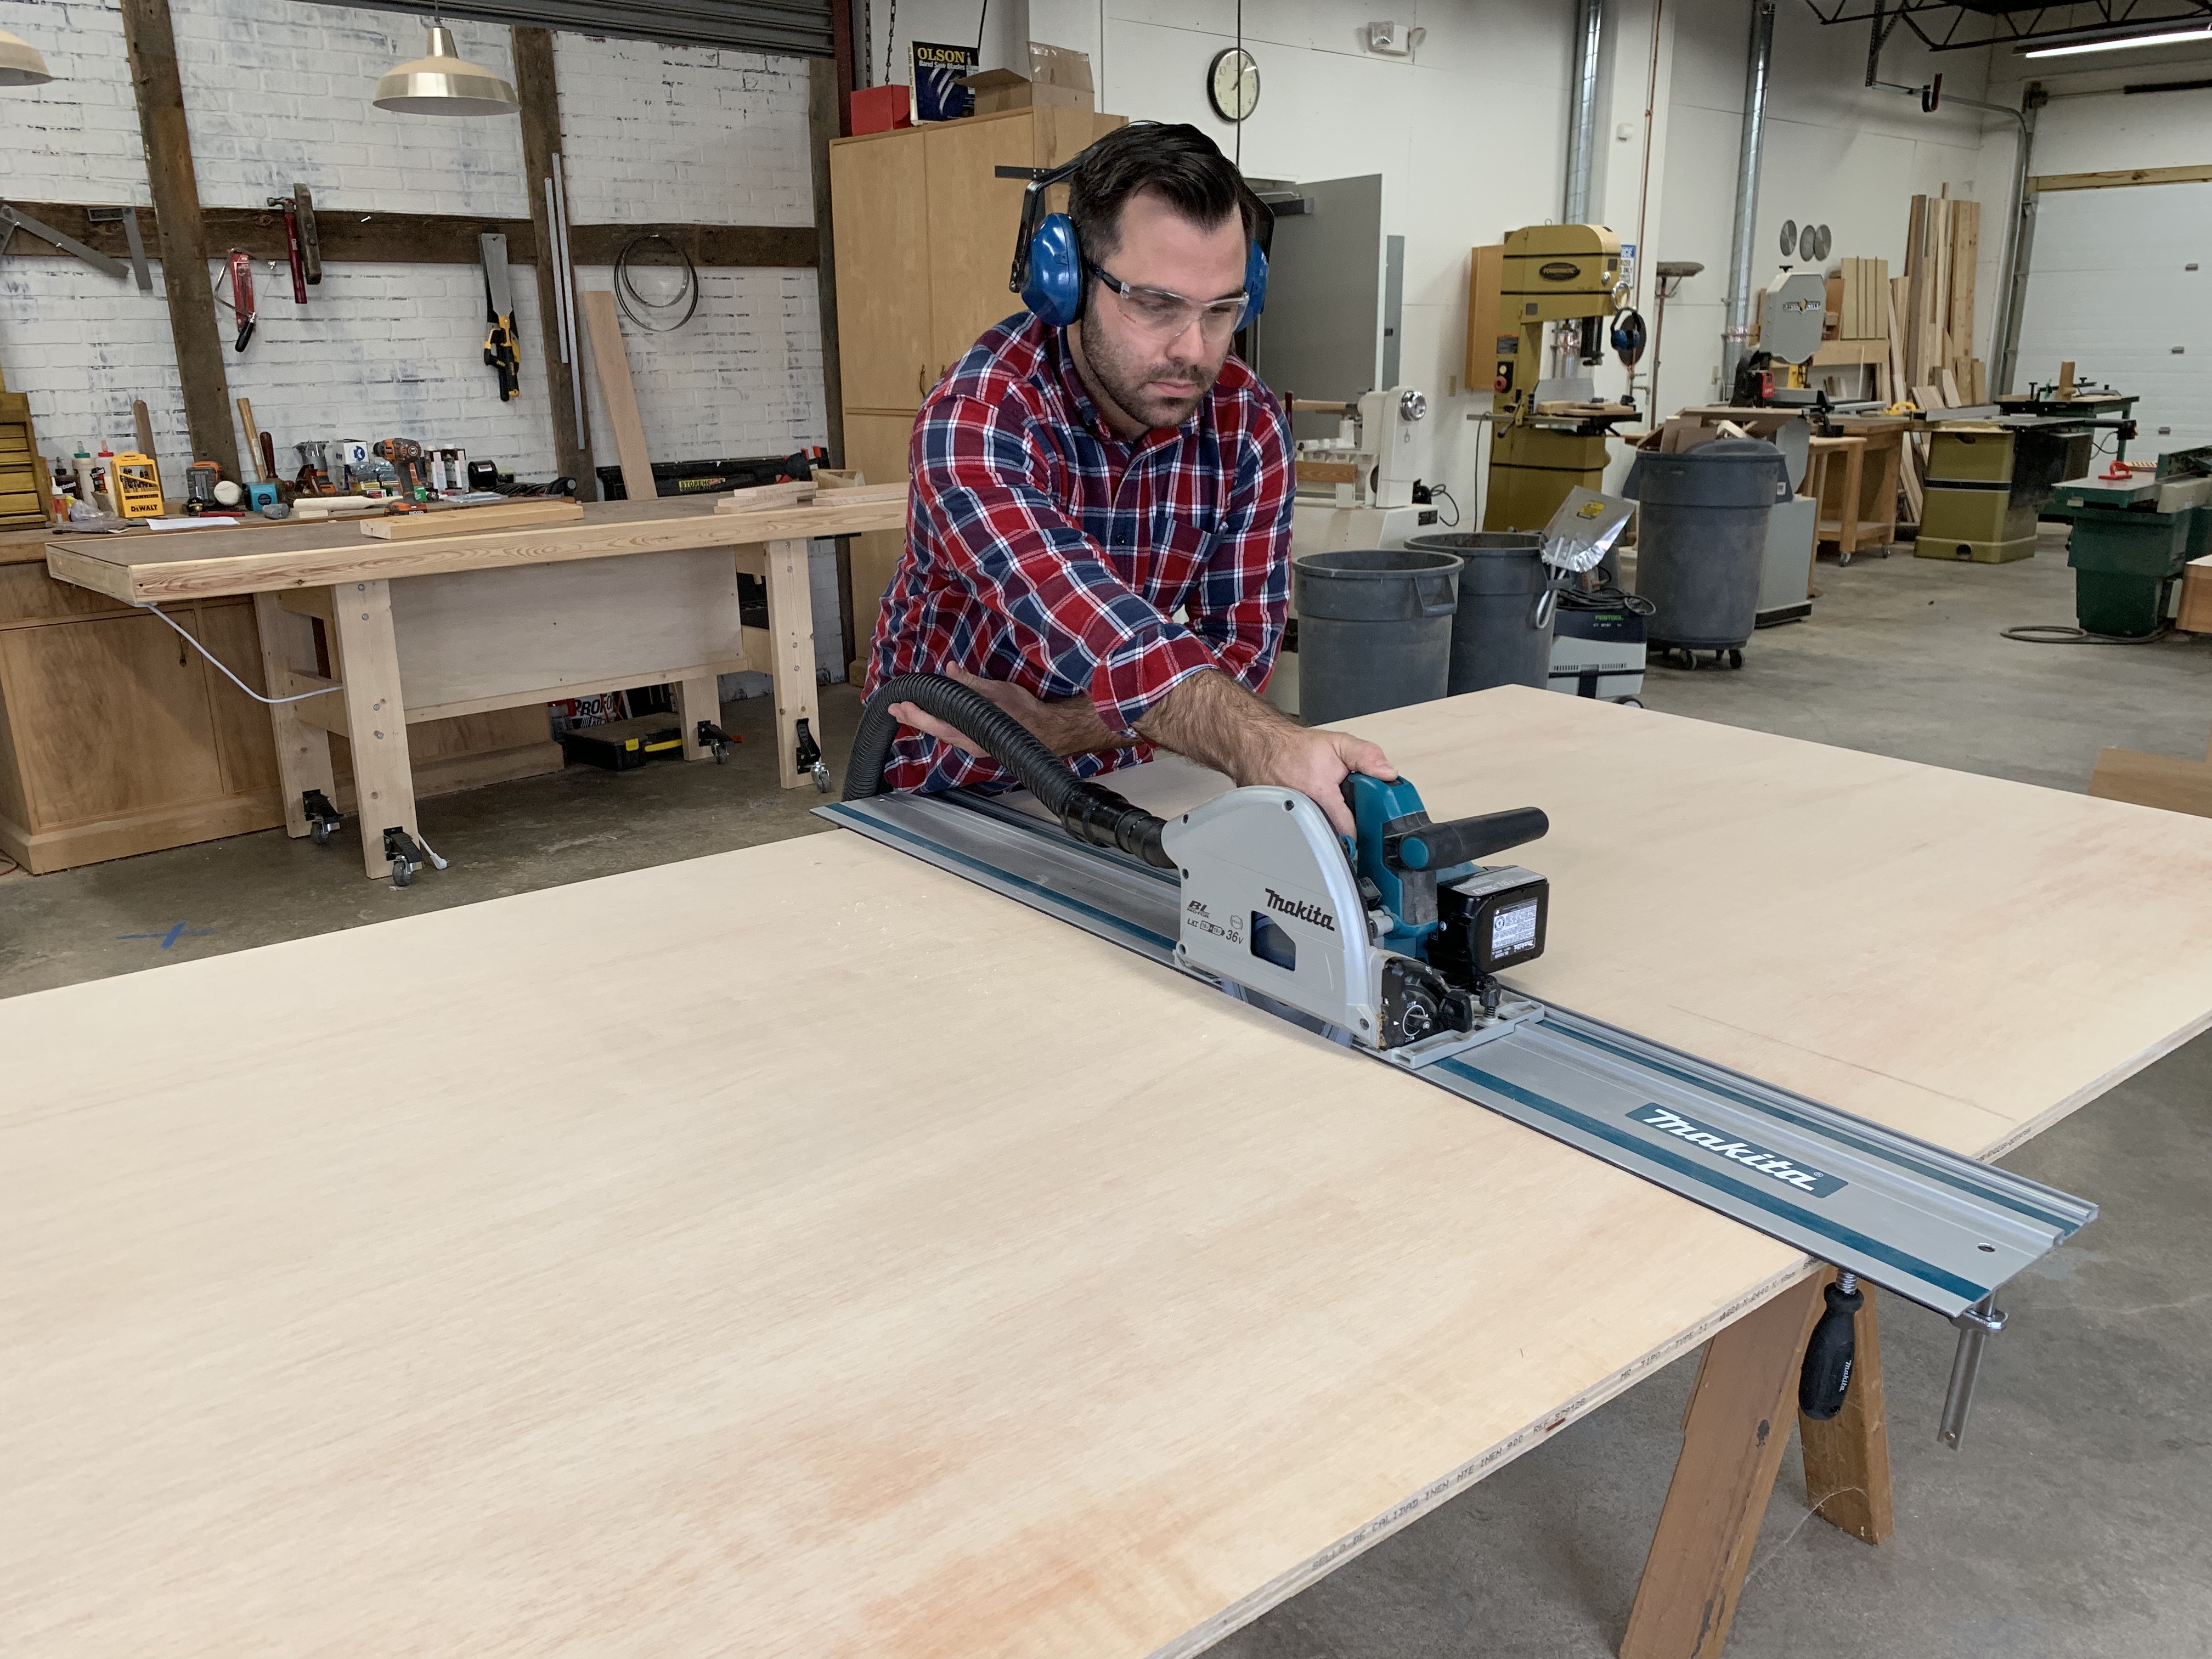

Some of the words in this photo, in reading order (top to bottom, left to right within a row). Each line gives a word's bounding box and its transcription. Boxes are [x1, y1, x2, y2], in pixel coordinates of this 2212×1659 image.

[917, 47, 964, 63] OLSON
[1187, 908, 1209, 919] MOTOR
[1188, 900, 1210, 915] BL
[1187, 918, 1199, 927] LXT
[1312, 1544, 1346, 1571] SELLO
[1352, 1530, 1366, 1546] DE
[1372, 1498, 1419, 1532] CALIDAD
[1425, 1480, 1449, 1500] INEN
[1457, 1464, 1475, 1482] NTE
[1480, 1447, 1503, 1468] INEN
[1506, 1435, 1523, 1451] 900
[1533, 1419, 1549, 1435] REF
[1641, 1351, 1661, 1368] TIPO
[1675, 1331, 1694, 1348] TYPE
